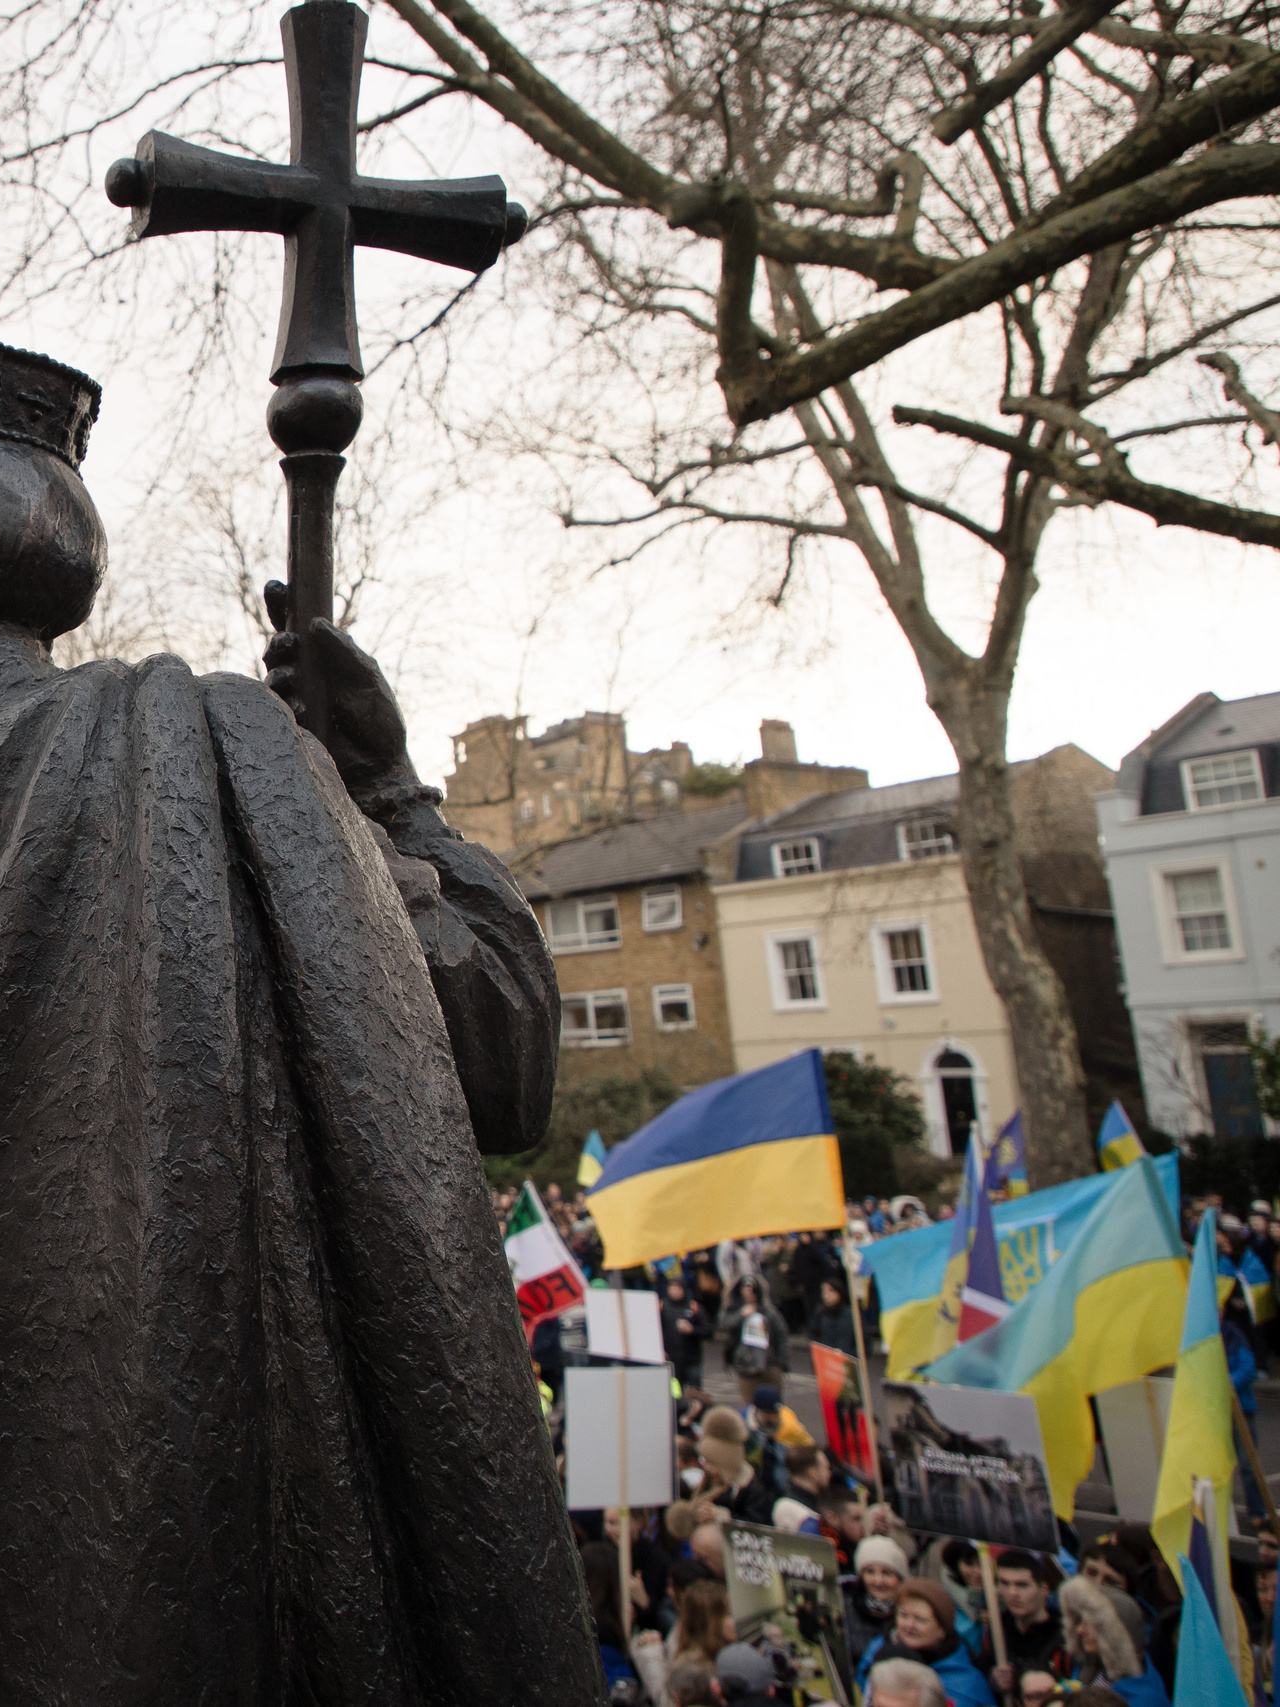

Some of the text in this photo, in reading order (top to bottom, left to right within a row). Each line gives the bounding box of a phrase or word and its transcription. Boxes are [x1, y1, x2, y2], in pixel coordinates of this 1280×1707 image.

[731, 1530, 773, 1552] SAVE
[734, 1550, 824, 1581] UKRAINIAN
[737, 1567, 773, 1587] KIDS
